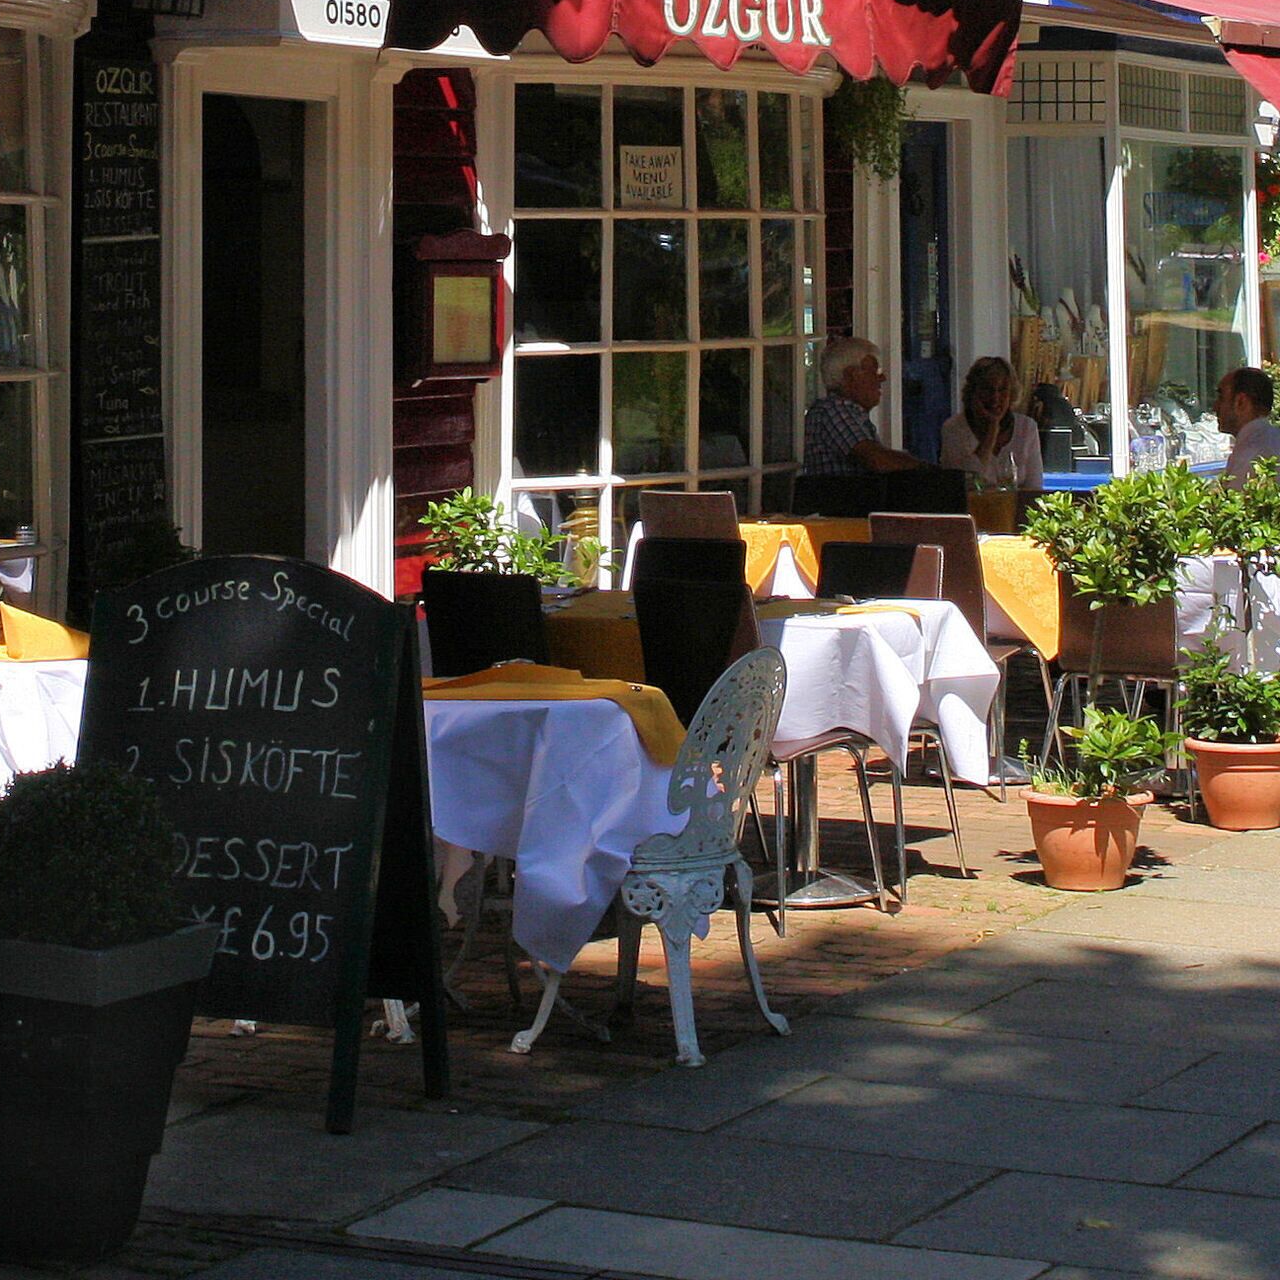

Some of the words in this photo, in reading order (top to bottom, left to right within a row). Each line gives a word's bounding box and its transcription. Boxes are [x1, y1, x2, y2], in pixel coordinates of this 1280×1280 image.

[626, 182, 673, 201] AVAILABLE
[632, 169, 667, 185] MENU
[127, 604, 149, 645] 3
[156, 580, 250, 619] course
[260, 571, 356, 643] Special
[171, 667, 342, 712] HUMUS
